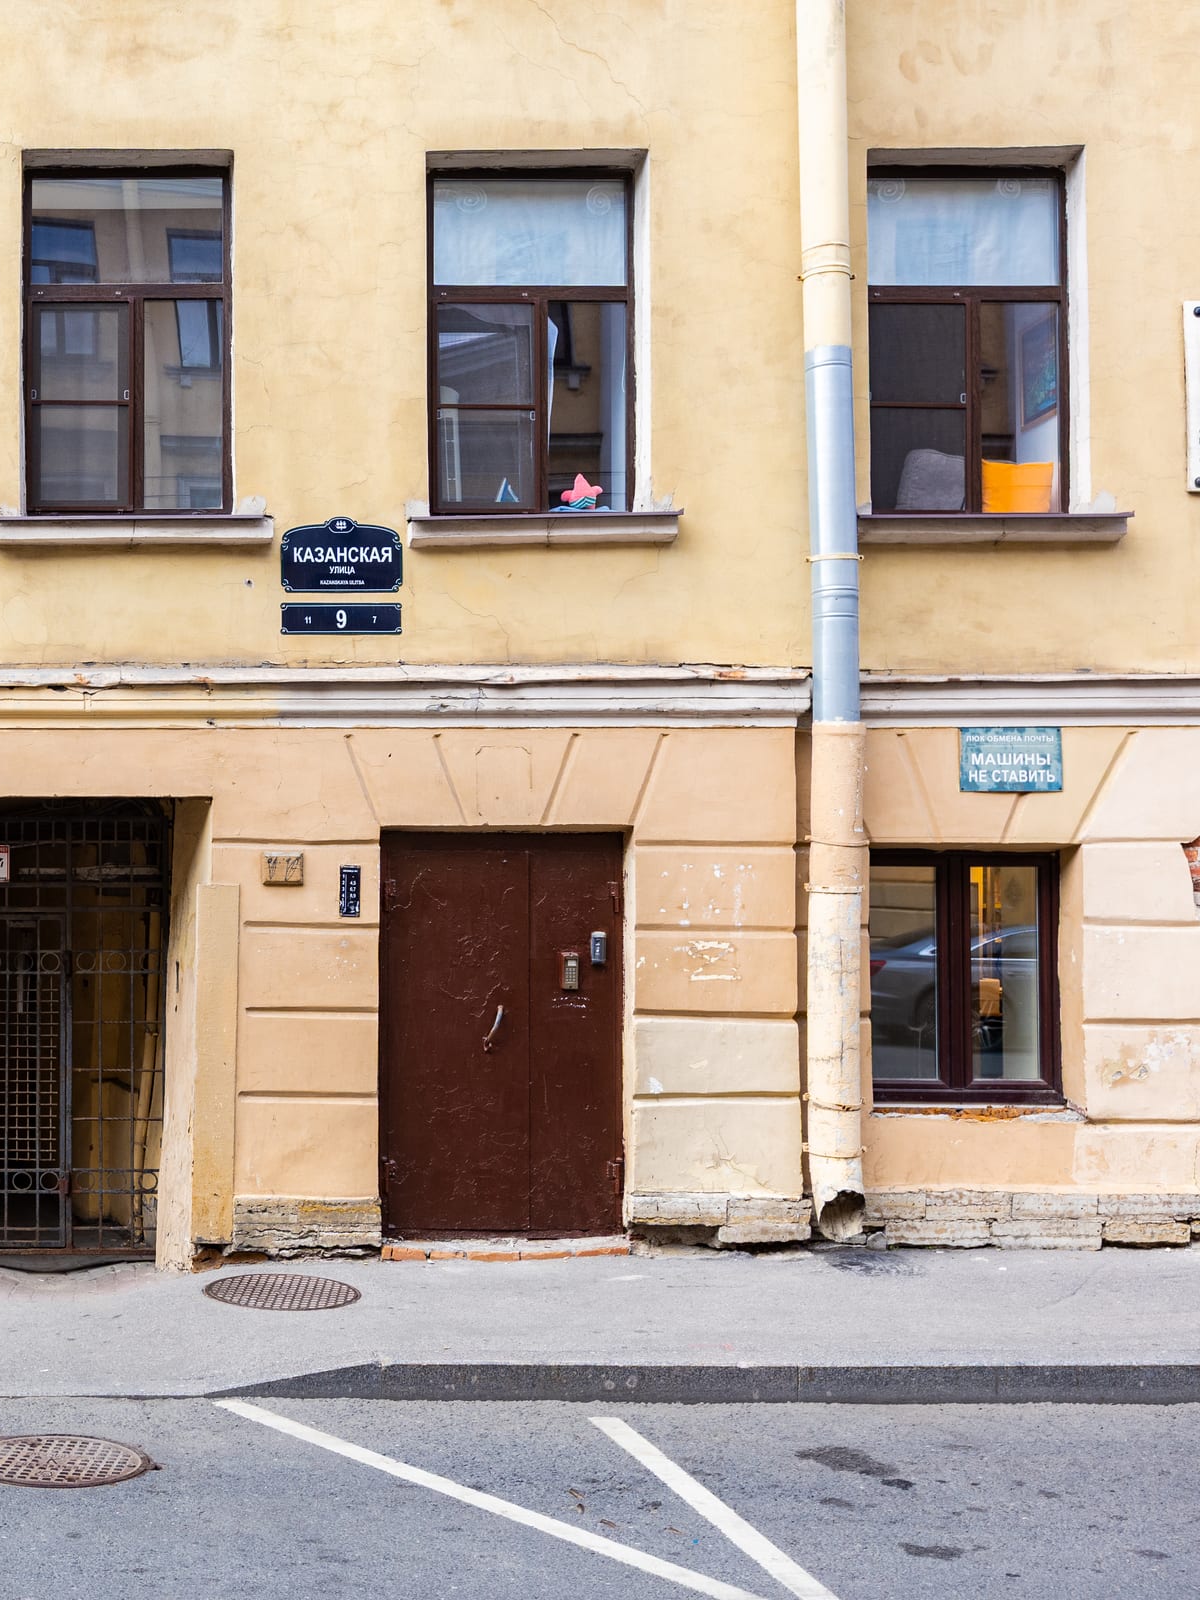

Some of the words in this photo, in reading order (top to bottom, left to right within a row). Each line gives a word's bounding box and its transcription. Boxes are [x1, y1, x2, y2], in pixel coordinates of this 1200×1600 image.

[293, 547, 392, 563] КАЗАНСКАЯ
[329, 566, 356, 575] УЛИЦА
[304, 616, 312, 624] 11
[336, 609, 347, 629] 9
[372, 615, 377, 624] 7
[971, 753, 1051, 766] МАШИНЫ
[968, 769, 987, 783] НЕ
[991, 769, 1056, 783] СТАВИТЬ
